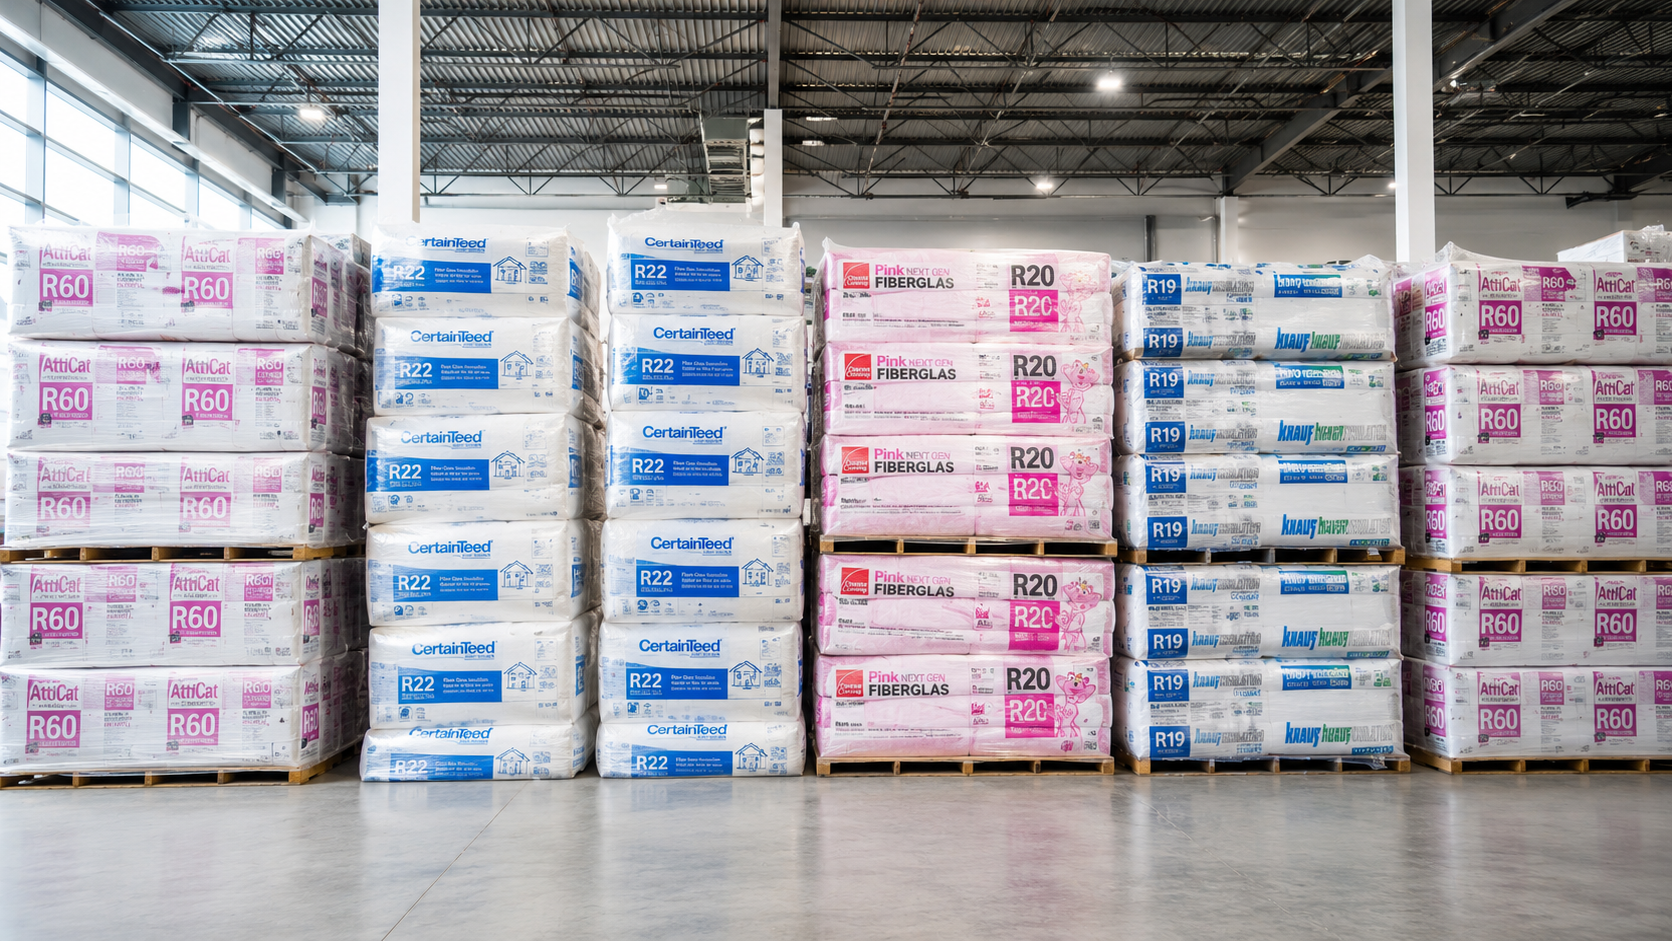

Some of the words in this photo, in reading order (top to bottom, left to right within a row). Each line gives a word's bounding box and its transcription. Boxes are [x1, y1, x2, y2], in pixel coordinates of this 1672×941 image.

[392, 265, 425, 280] R22
[635, 264, 667, 279] R22
[875, 264, 904, 276] Pink
[1011, 264, 1054, 287] R20
[42, 274, 89, 299] R60
[184, 277, 229, 300] R60
[875, 277, 954, 289] FIBERGLAS
[1148, 278, 1175, 294] R19
[1543, 277, 1564, 288] R60
[1481, 306, 1519, 327] R60
[1596, 307, 1634, 328] R60
[411, 330, 492, 343] CertainTeed
[653, 327, 733, 340] CertainTeed
[1150, 333, 1178, 349] R19
[642, 359, 674, 373] R22
[877, 355, 906, 367] Pink
[1013, 354, 1057, 377] R20
[400, 363, 432, 378] R22
[877, 368, 956, 380] FIBERGLAS
[1150, 372, 1178, 387] R19
[42, 387, 89, 412] R60
[185, 388, 229, 413] R60
[1481, 408, 1518, 429] R60
[1596, 409, 1633, 429] R60
[401, 430, 482, 444] CertainTeed
[642, 426, 722, 439] CertainTeed
[1150, 427, 1181, 443] R19
[874, 448, 904, 460] Pink
[1011, 446, 1054, 469] R20
[389, 464, 422, 480] R22
[632, 459, 664, 473] R22
[874, 461, 954, 473] FIBERGLAS
[1151, 468, 1181, 482] R19
[40, 495, 86, 520] R60
[182, 496, 227, 520] R60
[1481, 509, 1519, 530] R60
[1597, 510, 1634, 530] R60
[1153, 521, 1182, 538] R19
[408, 541, 491, 554] CertainTeed
[651, 537, 732, 550] CertainTeed
[398, 575, 431, 590] R22
[640, 571, 673, 586] R22
[874, 571, 905, 583] Pink
[874, 583, 954, 597] FIBERGLAS
[1013, 574, 1057, 597] R20
[1152, 578, 1181, 594] R19
[32, 606, 79, 631] R60
[172, 605, 217, 629] R60
[1481, 613, 1519, 634] R60
[1597, 613, 1634, 634] R60
[412, 641, 495, 655] CertainTeed
[639, 639, 720, 652] CertainTeed
[1153, 633, 1183, 650] R19
[401, 677, 435, 691] R22
[630, 673, 662, 688] R22
[869, 670, 899, 683] Pink
[1007, 667, 1050, 690] R20
[1154, 675, 1183, 691] R19
[869, 684, 949, 696] FIBERGLAS
[170, 713, 215, 737] R60
[1480, 708, 1518, 729] R60
[1596, 708, 1634, 729] R60
[29, 714, 77, 740] R60
[647, 724, 727, 735] CertainTeed
[1155, 731, 1185, 747] R19
[395, 760, 428, 775] R22
[636, 756, 668, 770] R22
